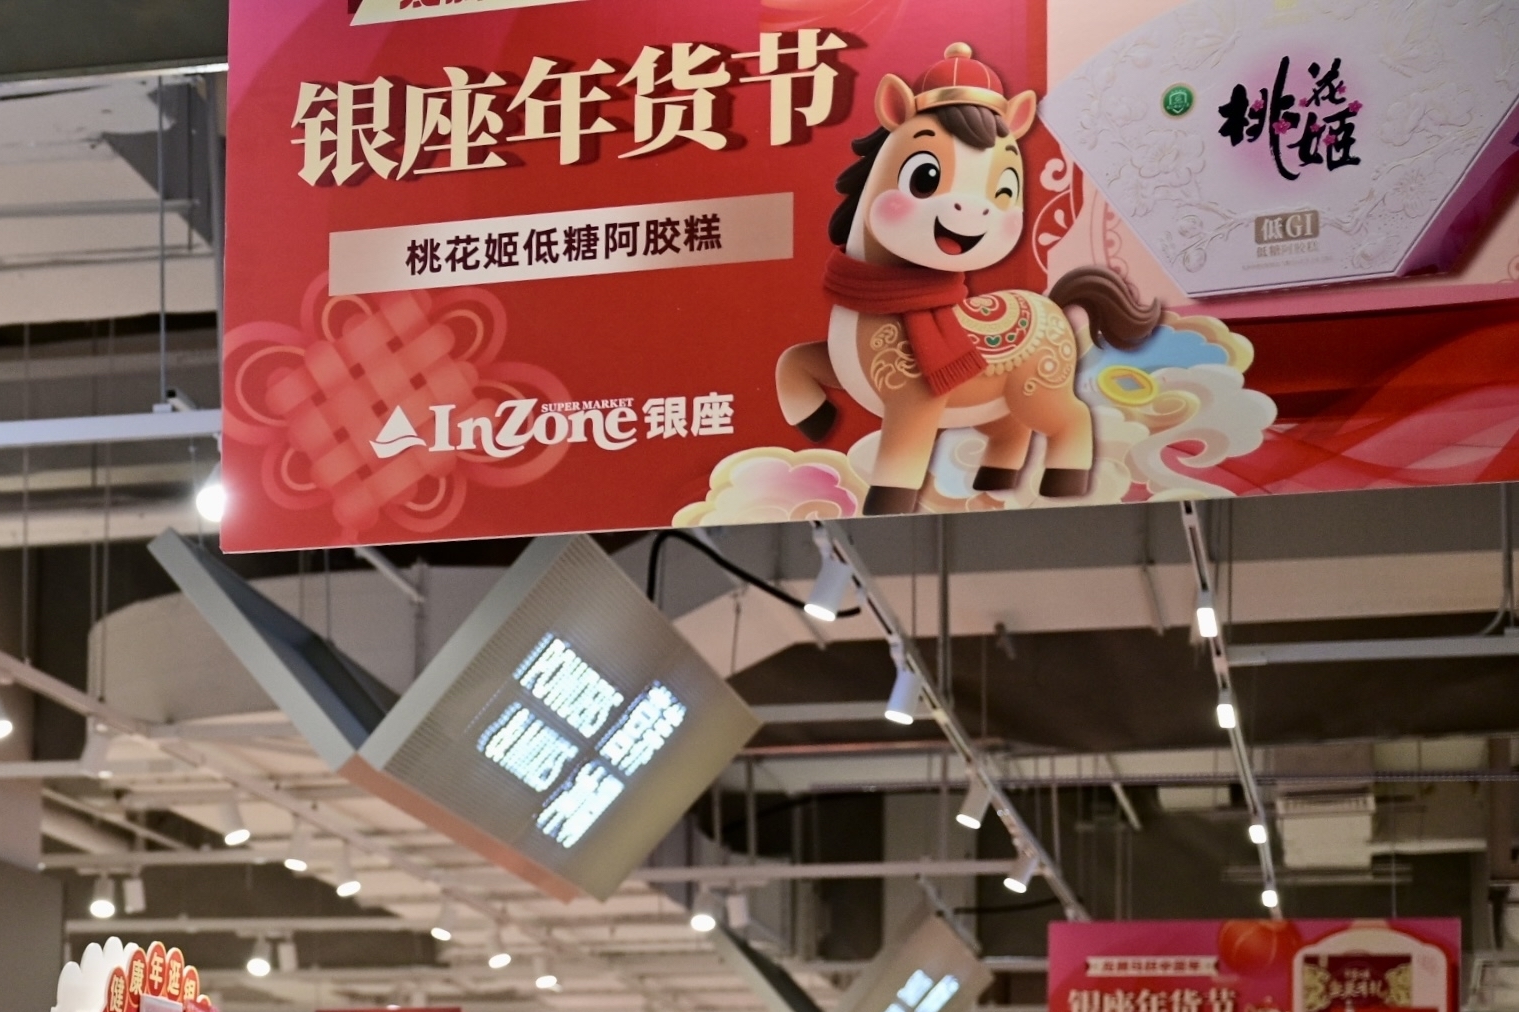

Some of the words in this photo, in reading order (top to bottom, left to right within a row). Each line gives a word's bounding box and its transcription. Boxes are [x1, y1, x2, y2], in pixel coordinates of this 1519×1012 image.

[290, 27, 849, 187] 银座年货节
[1218, 56, 1364, 180] 桃花姬
[406, 213, 722, 276] 桃花姬低糖阿胶糕
[428, 399, 637, 458] InZone
[540, 402, 581, 413] SUPER
[583, 397, 634, 410] MARKET
[642, 391, 734, 440] 银座
